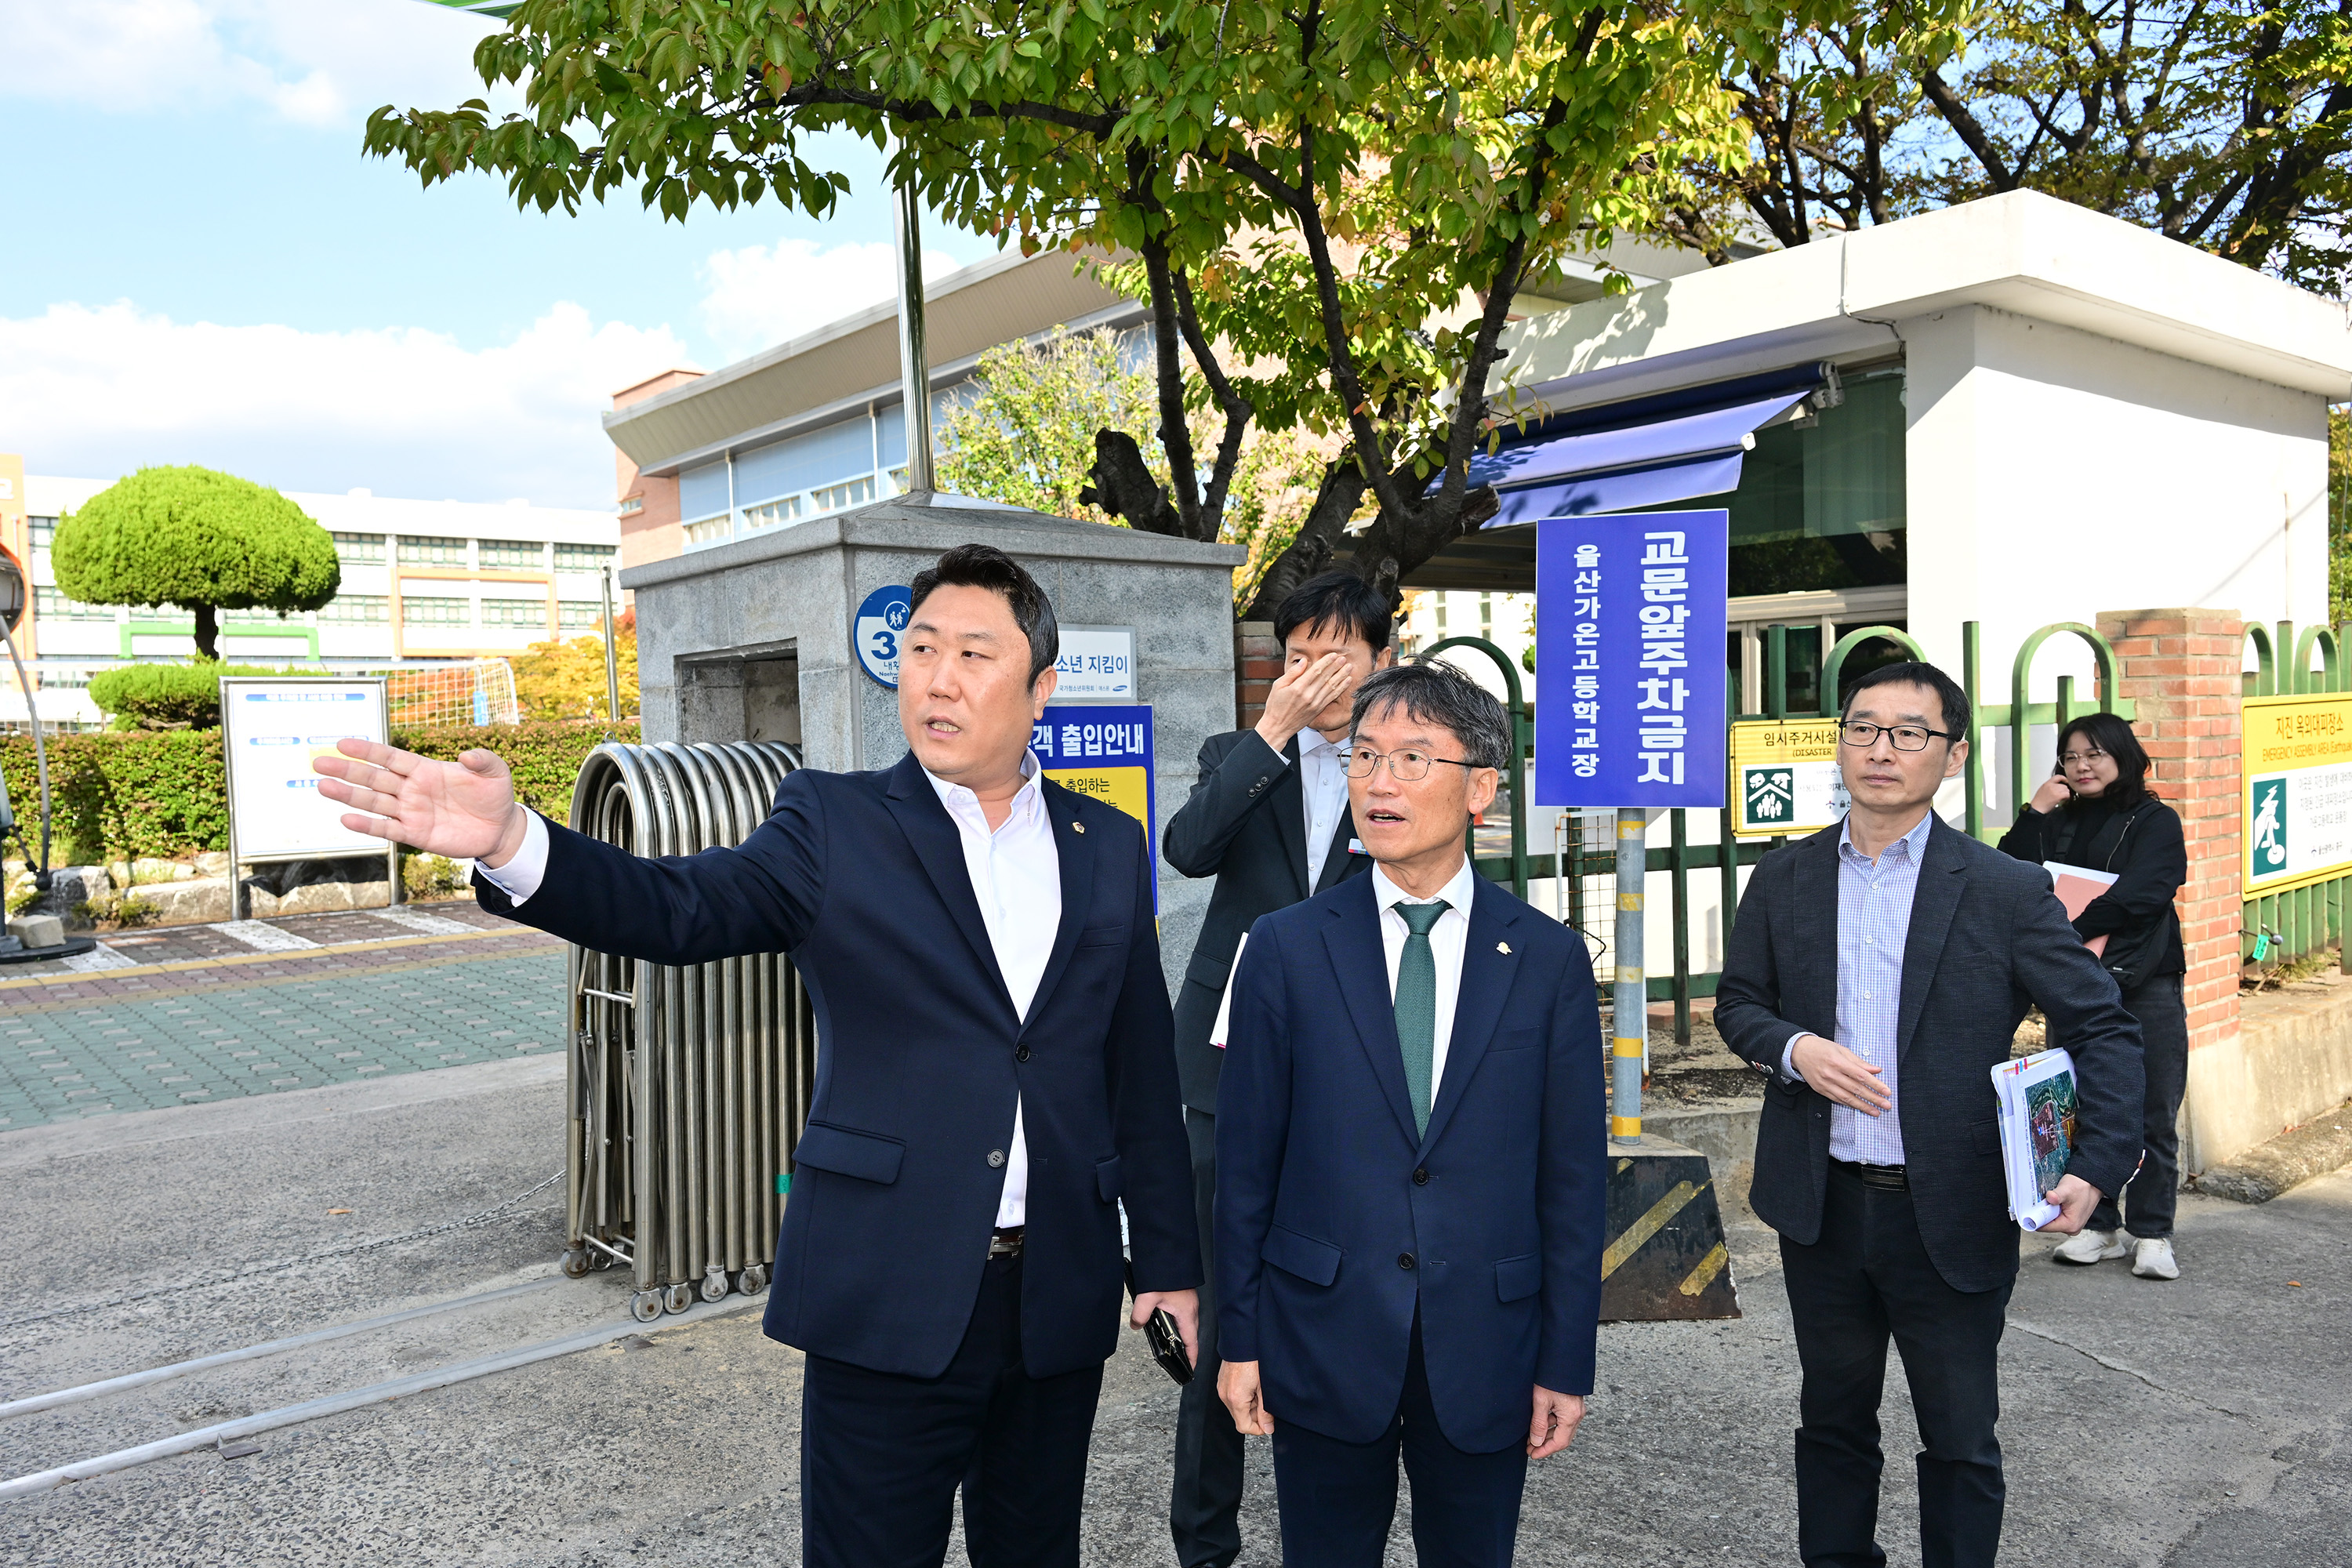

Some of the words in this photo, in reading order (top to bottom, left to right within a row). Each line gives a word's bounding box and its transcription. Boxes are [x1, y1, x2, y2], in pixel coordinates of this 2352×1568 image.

[871, 631, 898, 660] 3
[1637, 531, 1691, 785] 교문앞주차금지
[1055, 655, 1082, 673] 소년
[1088, 655, 1127, 673] 지킴이
[1571, 544, 1602, 778] 울산가온고등학교장
[1764, 730, 1837, 746] 임시주거시설
[2276, 715, 2292, 739] 지진
[2296, 713, 2343, 738] 옥외대피장소
[1028, 725, 1053, 757] 객
[1062, 724, 1144, 757] 출입안내
[1792, 749, 1832, 757] (DISASTER
